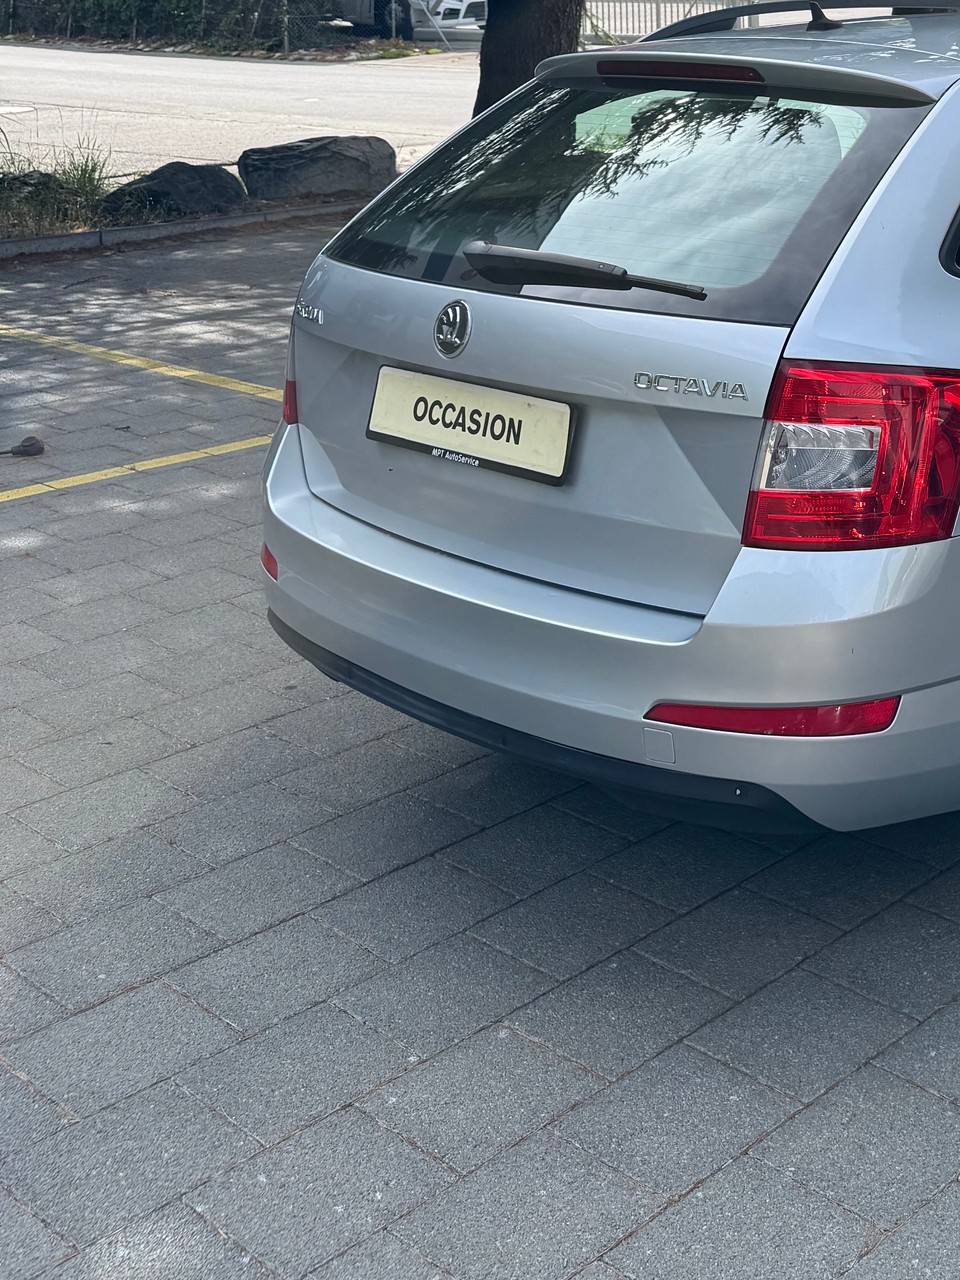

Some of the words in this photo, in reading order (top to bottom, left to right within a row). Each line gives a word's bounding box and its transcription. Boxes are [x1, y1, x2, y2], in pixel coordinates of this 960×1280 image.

[633, 370, 749, 401] OCTAVIA
[413, 396, 523, 445] OCCASION
[431, 447, 445, 458] MPT
[445, 451, 480, 467] AutoService
